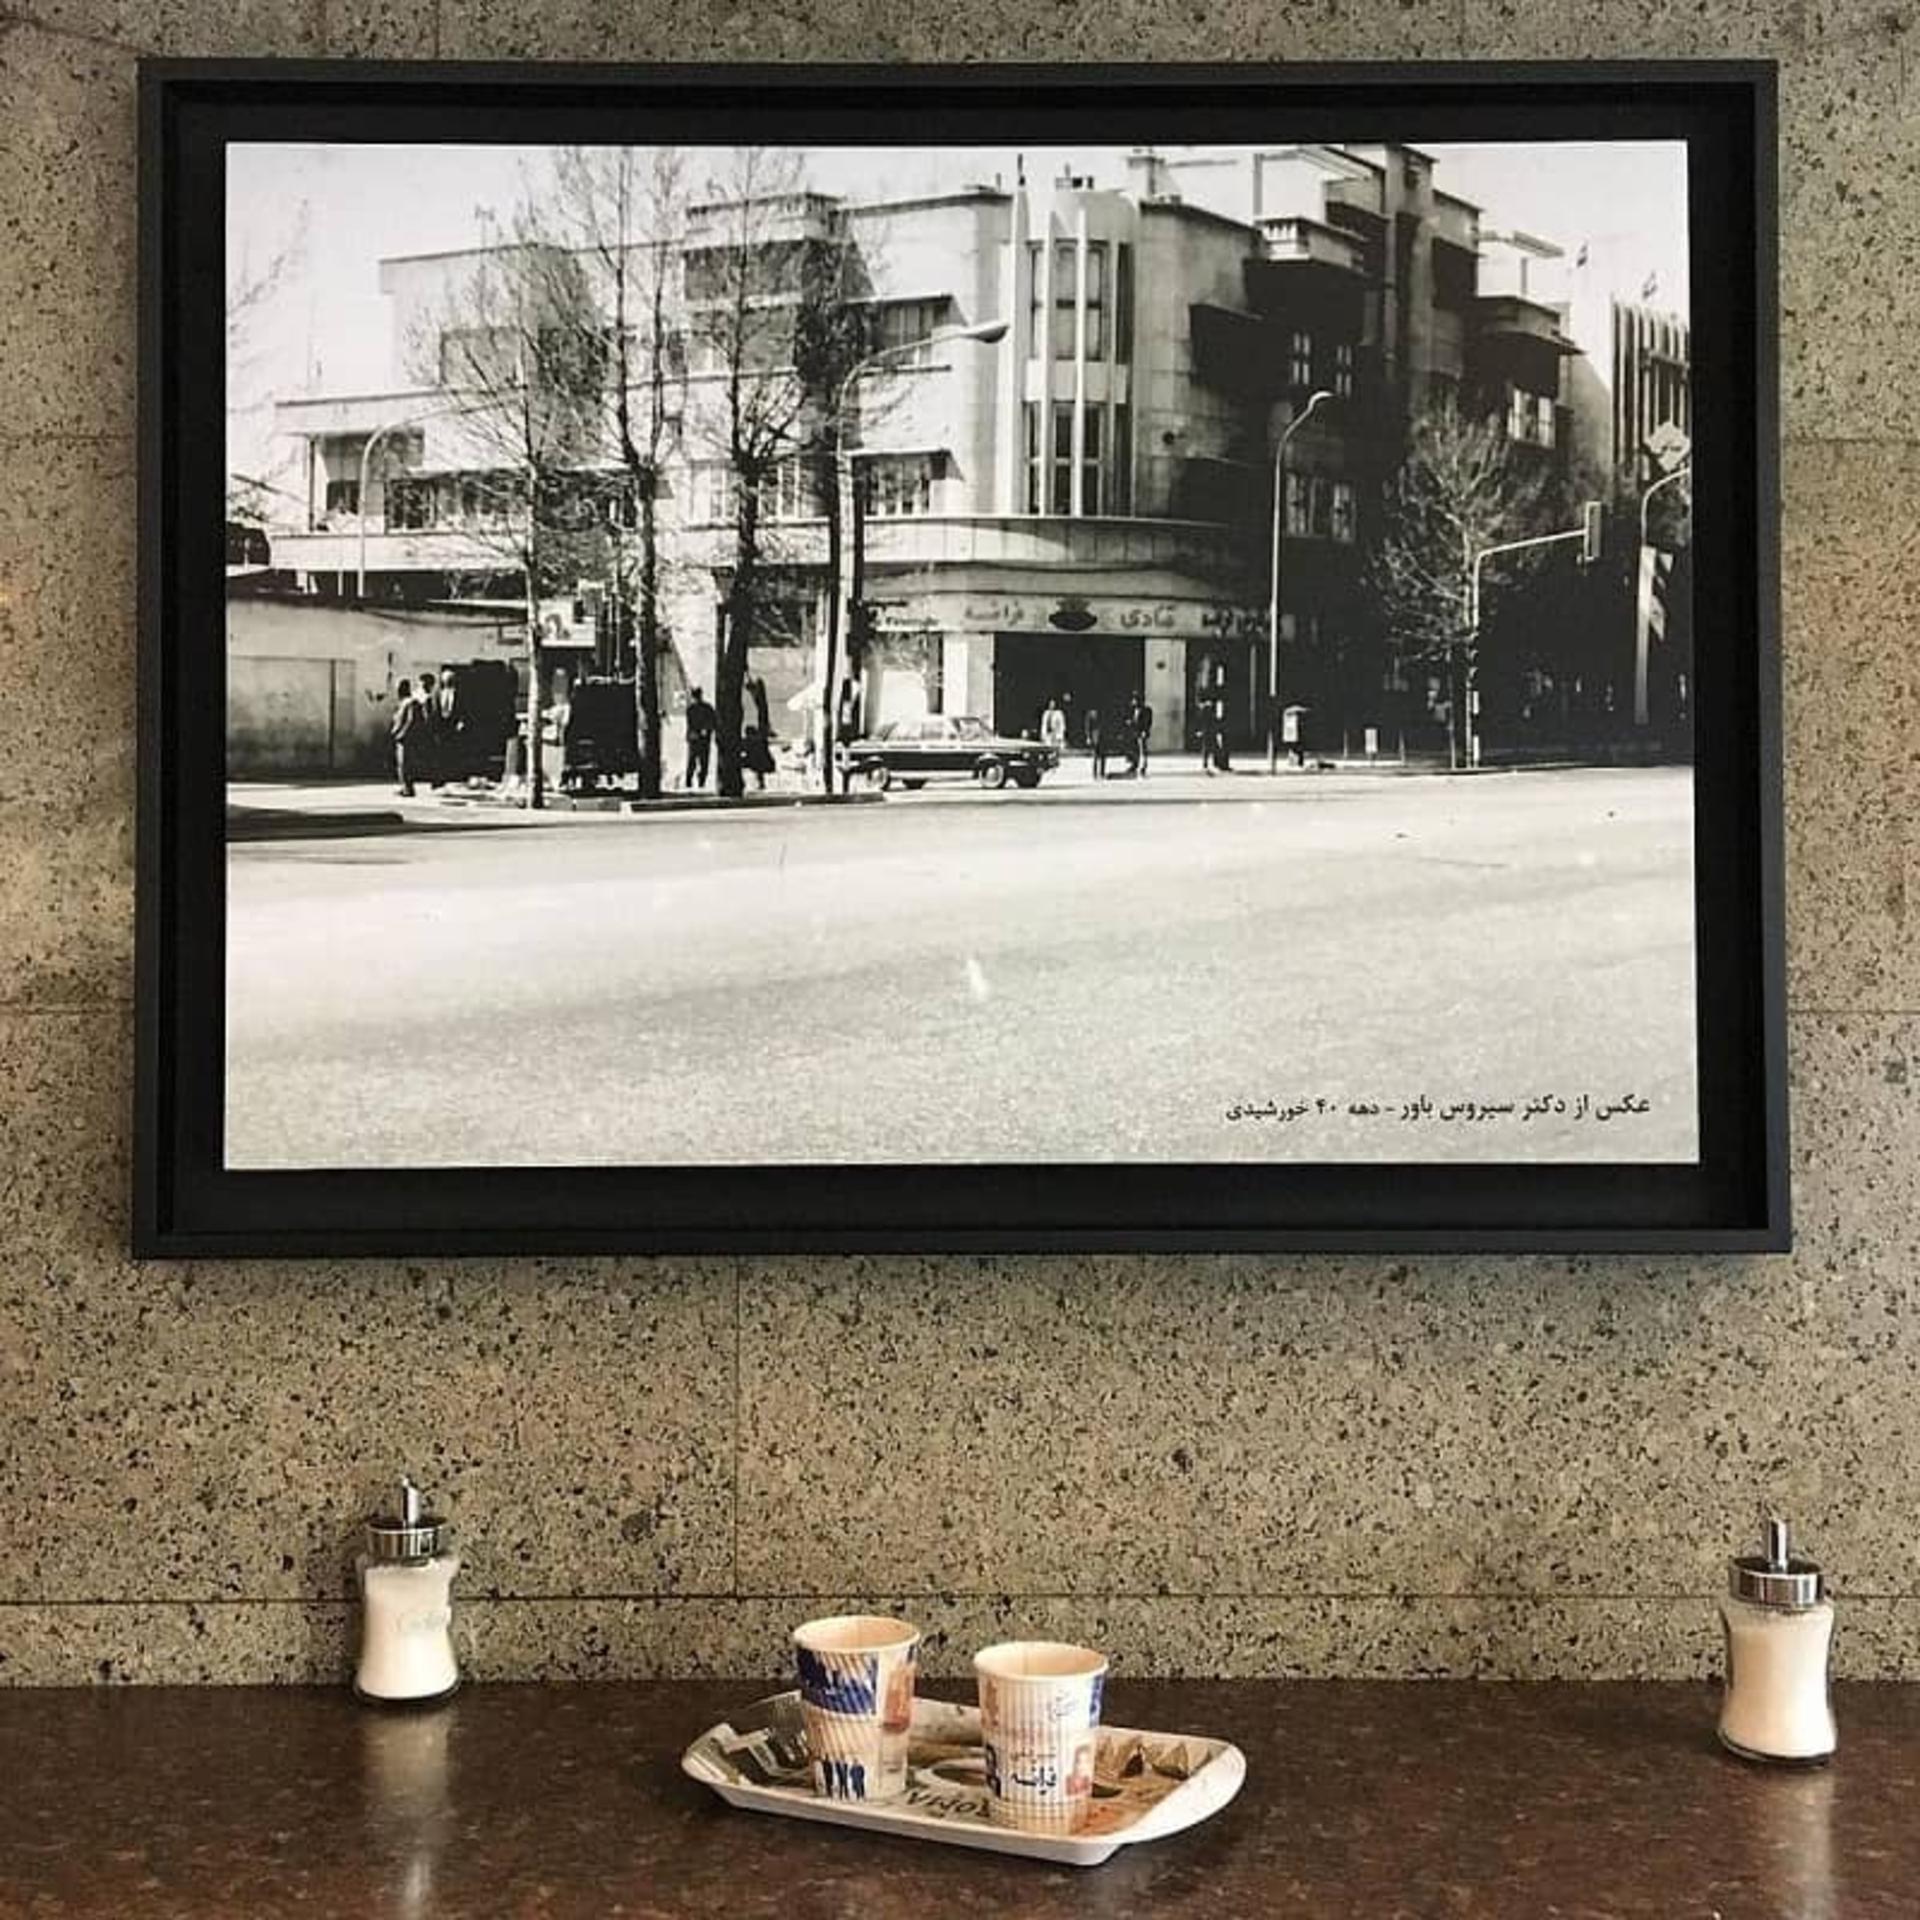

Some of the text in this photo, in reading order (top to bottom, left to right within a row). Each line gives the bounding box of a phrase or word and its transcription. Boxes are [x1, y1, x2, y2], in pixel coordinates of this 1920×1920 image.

[1226, 1100, 1309, 1121] خورشیدی
[1315, 1098, 1336, 1114] ۴۰
[1348, 1103, 1379, 1115] دهه
[1400, 1094, 1433, 1120] باور
[1440, 1101, 1515, 1121] سیروس
[1522, 1094, 1566, 1121] دکتر
[1573, 1094, 1588, 1120] از
[1596, 1094, 1650, 1121] عکس
